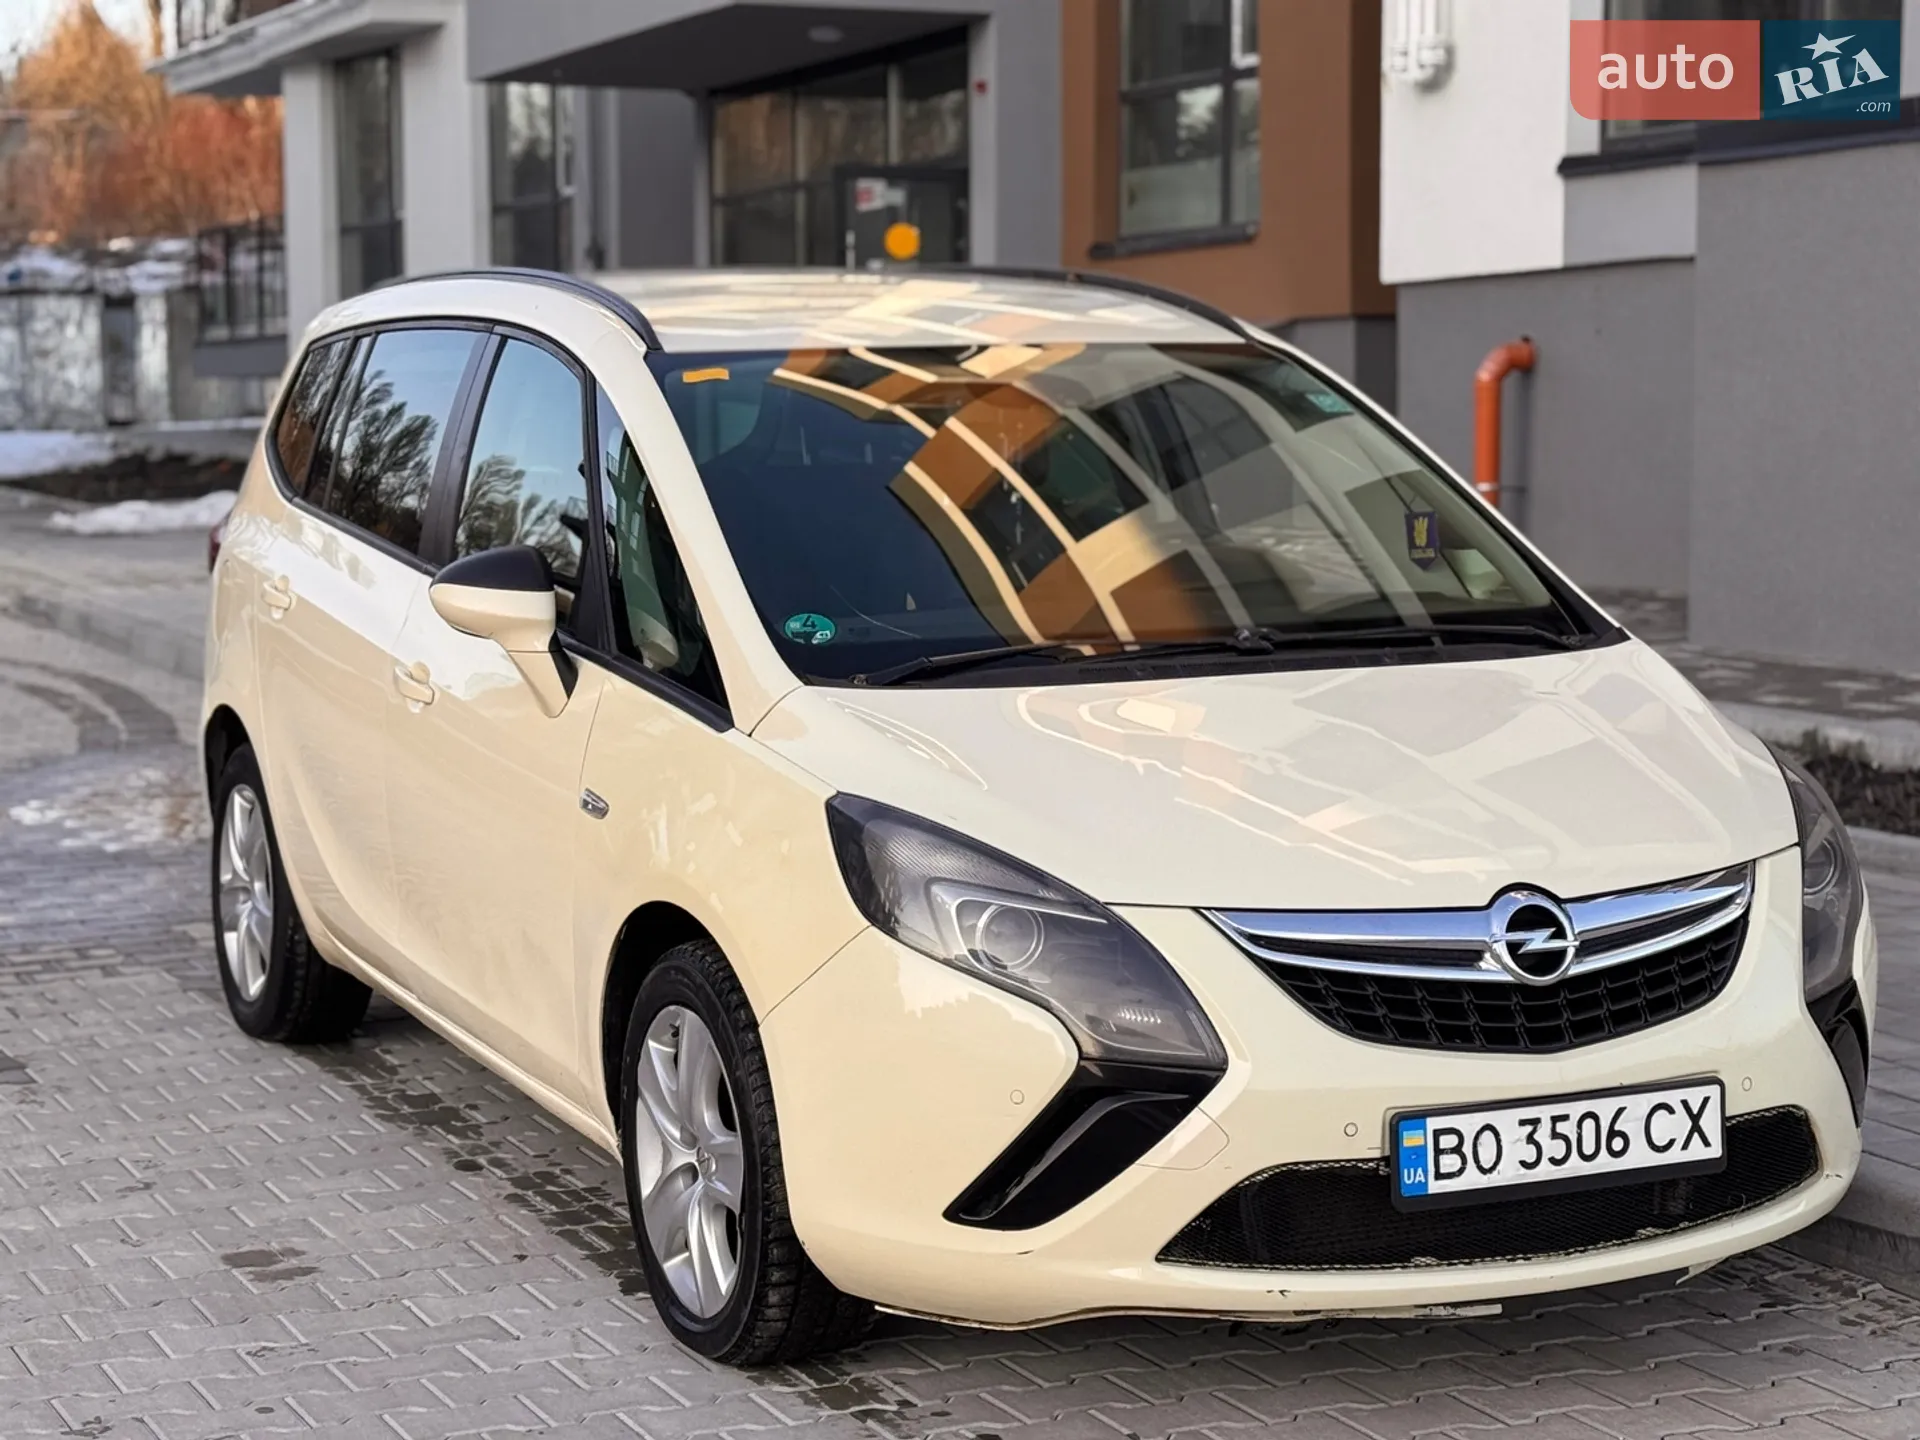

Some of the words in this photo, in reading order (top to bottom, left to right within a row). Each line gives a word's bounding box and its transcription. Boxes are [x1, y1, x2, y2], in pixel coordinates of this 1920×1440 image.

[1432, 1122, 1502, 1181] BO
[1518, 1106, 1631, 1171] 3506
[1644, 1096, 1712, 1154] CX
[1403, 1167, 1426, 1185] UA
